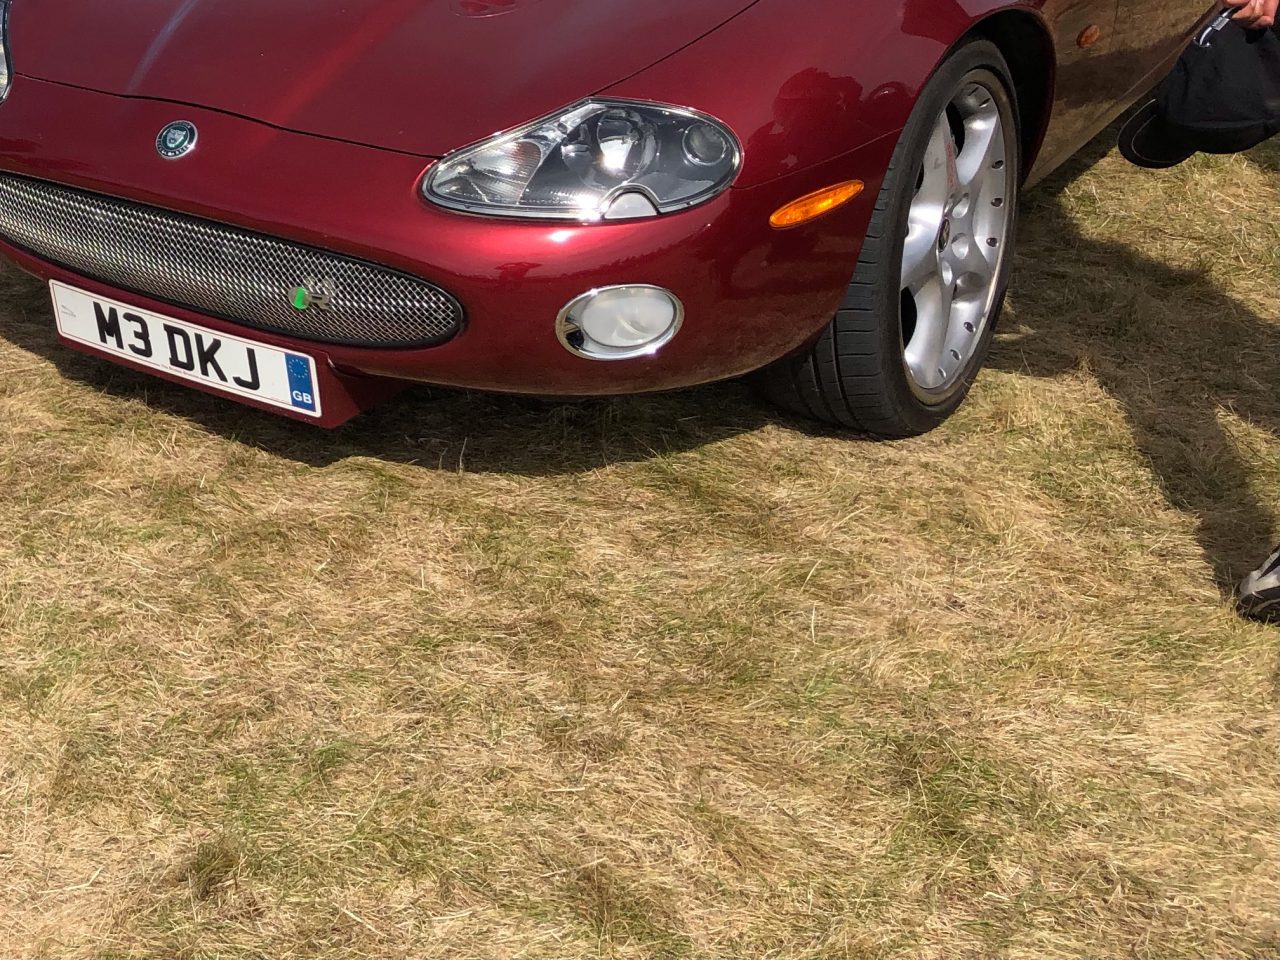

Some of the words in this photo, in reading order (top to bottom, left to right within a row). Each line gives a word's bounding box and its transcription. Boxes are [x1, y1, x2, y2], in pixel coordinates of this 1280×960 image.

[93, 301, 153, 358] M3
[163, 323, 260, 391] DKJ
[292, 390, 313, 404] GB
